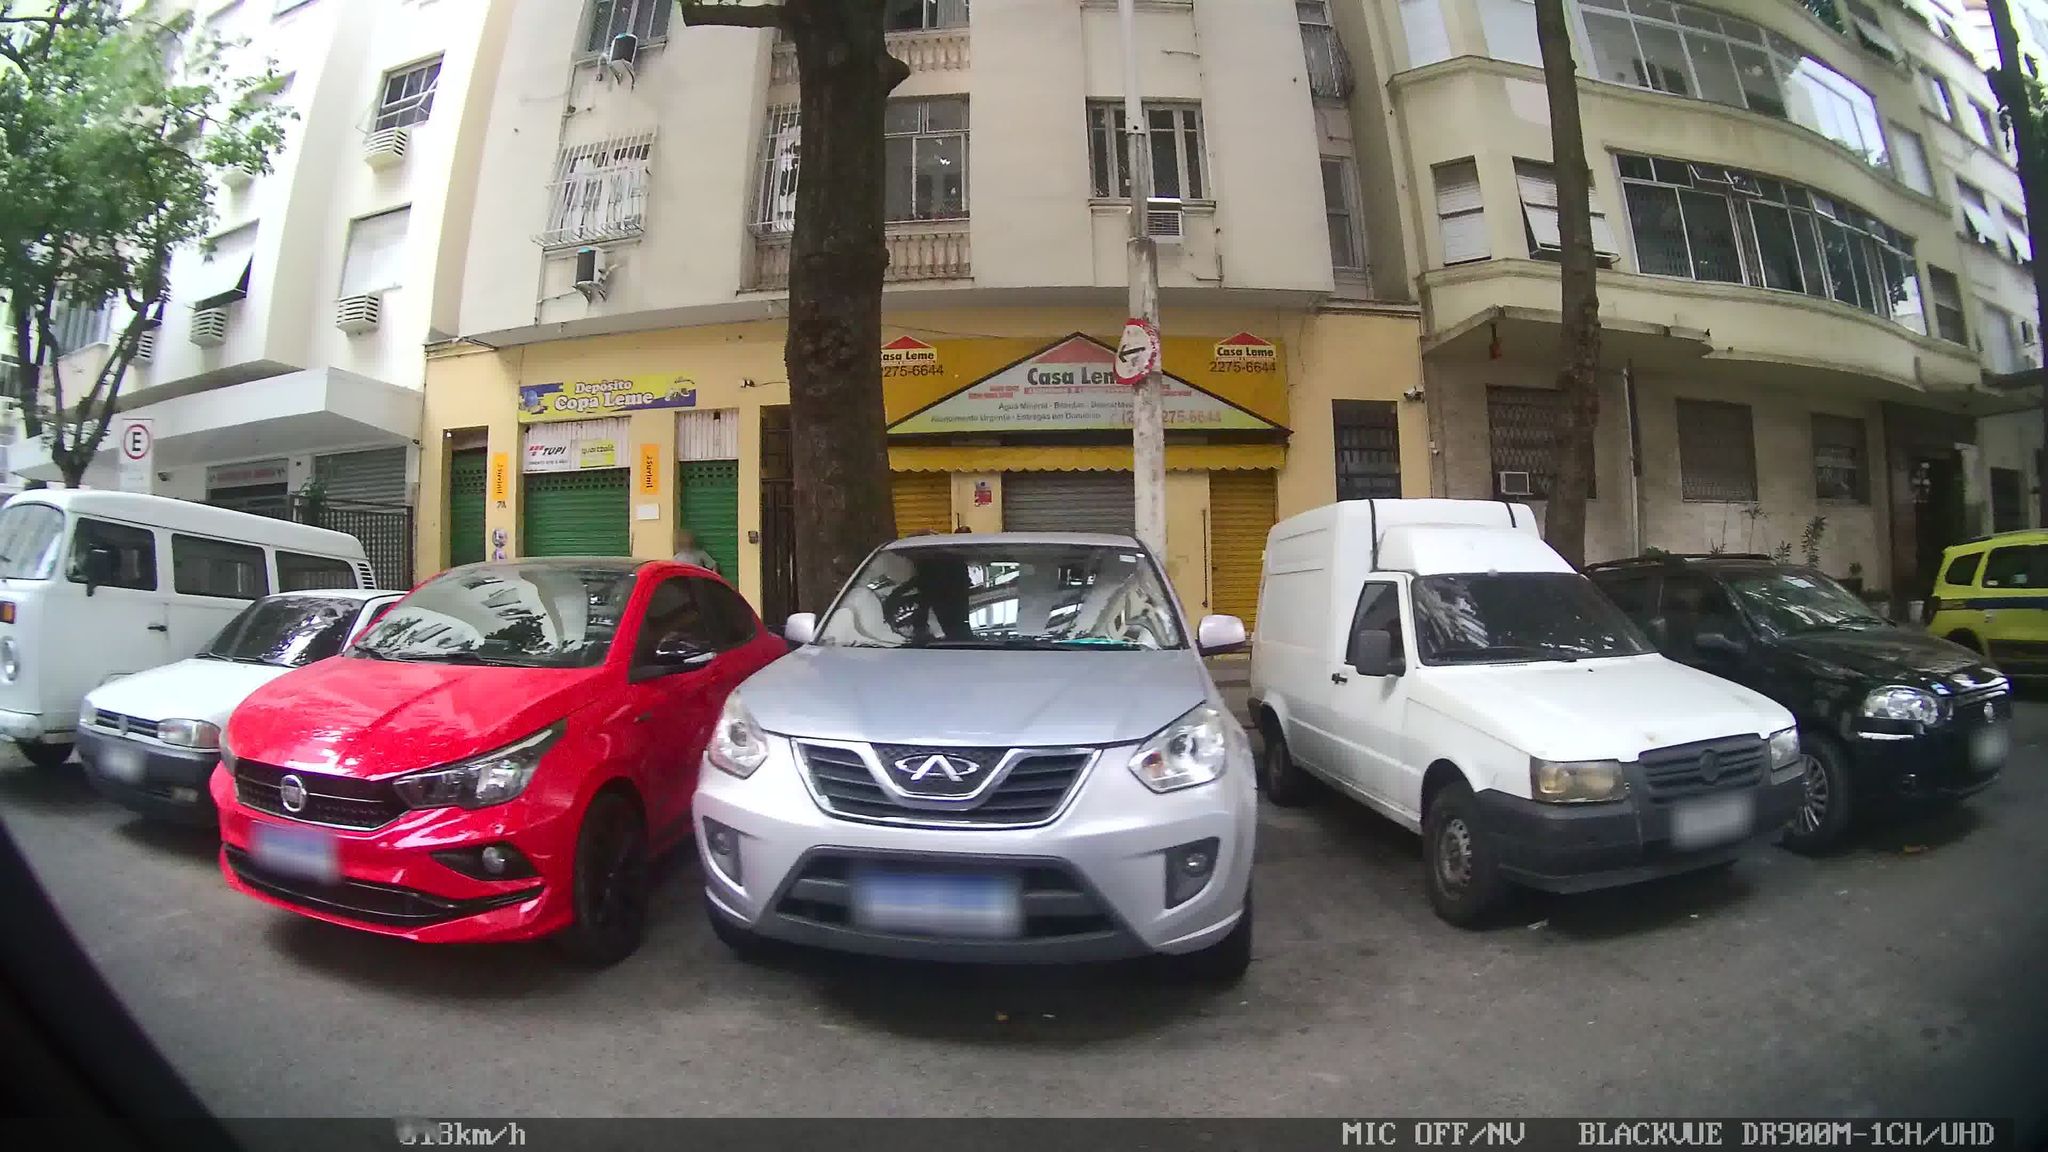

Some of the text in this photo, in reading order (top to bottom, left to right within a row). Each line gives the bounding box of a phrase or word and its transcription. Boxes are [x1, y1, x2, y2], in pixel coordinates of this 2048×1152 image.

[880, 351, 935, 361] asa Leme
[1217, 347, 1274, 357] Casa Leme
[881, 365, 944, 378] 275-6644
[1209, 361, 1277, 374] 2275-6644
[1027, 366, 1116, 386] Casa Lem
[575, 379, 633, 395] Depósito
[554, 390, 654, 414] Copa Leme
[1162, 409, 1222, 423] 275-6644
[131, 431, 142, 452] E
[542, 445, 567, 456] TUPI
